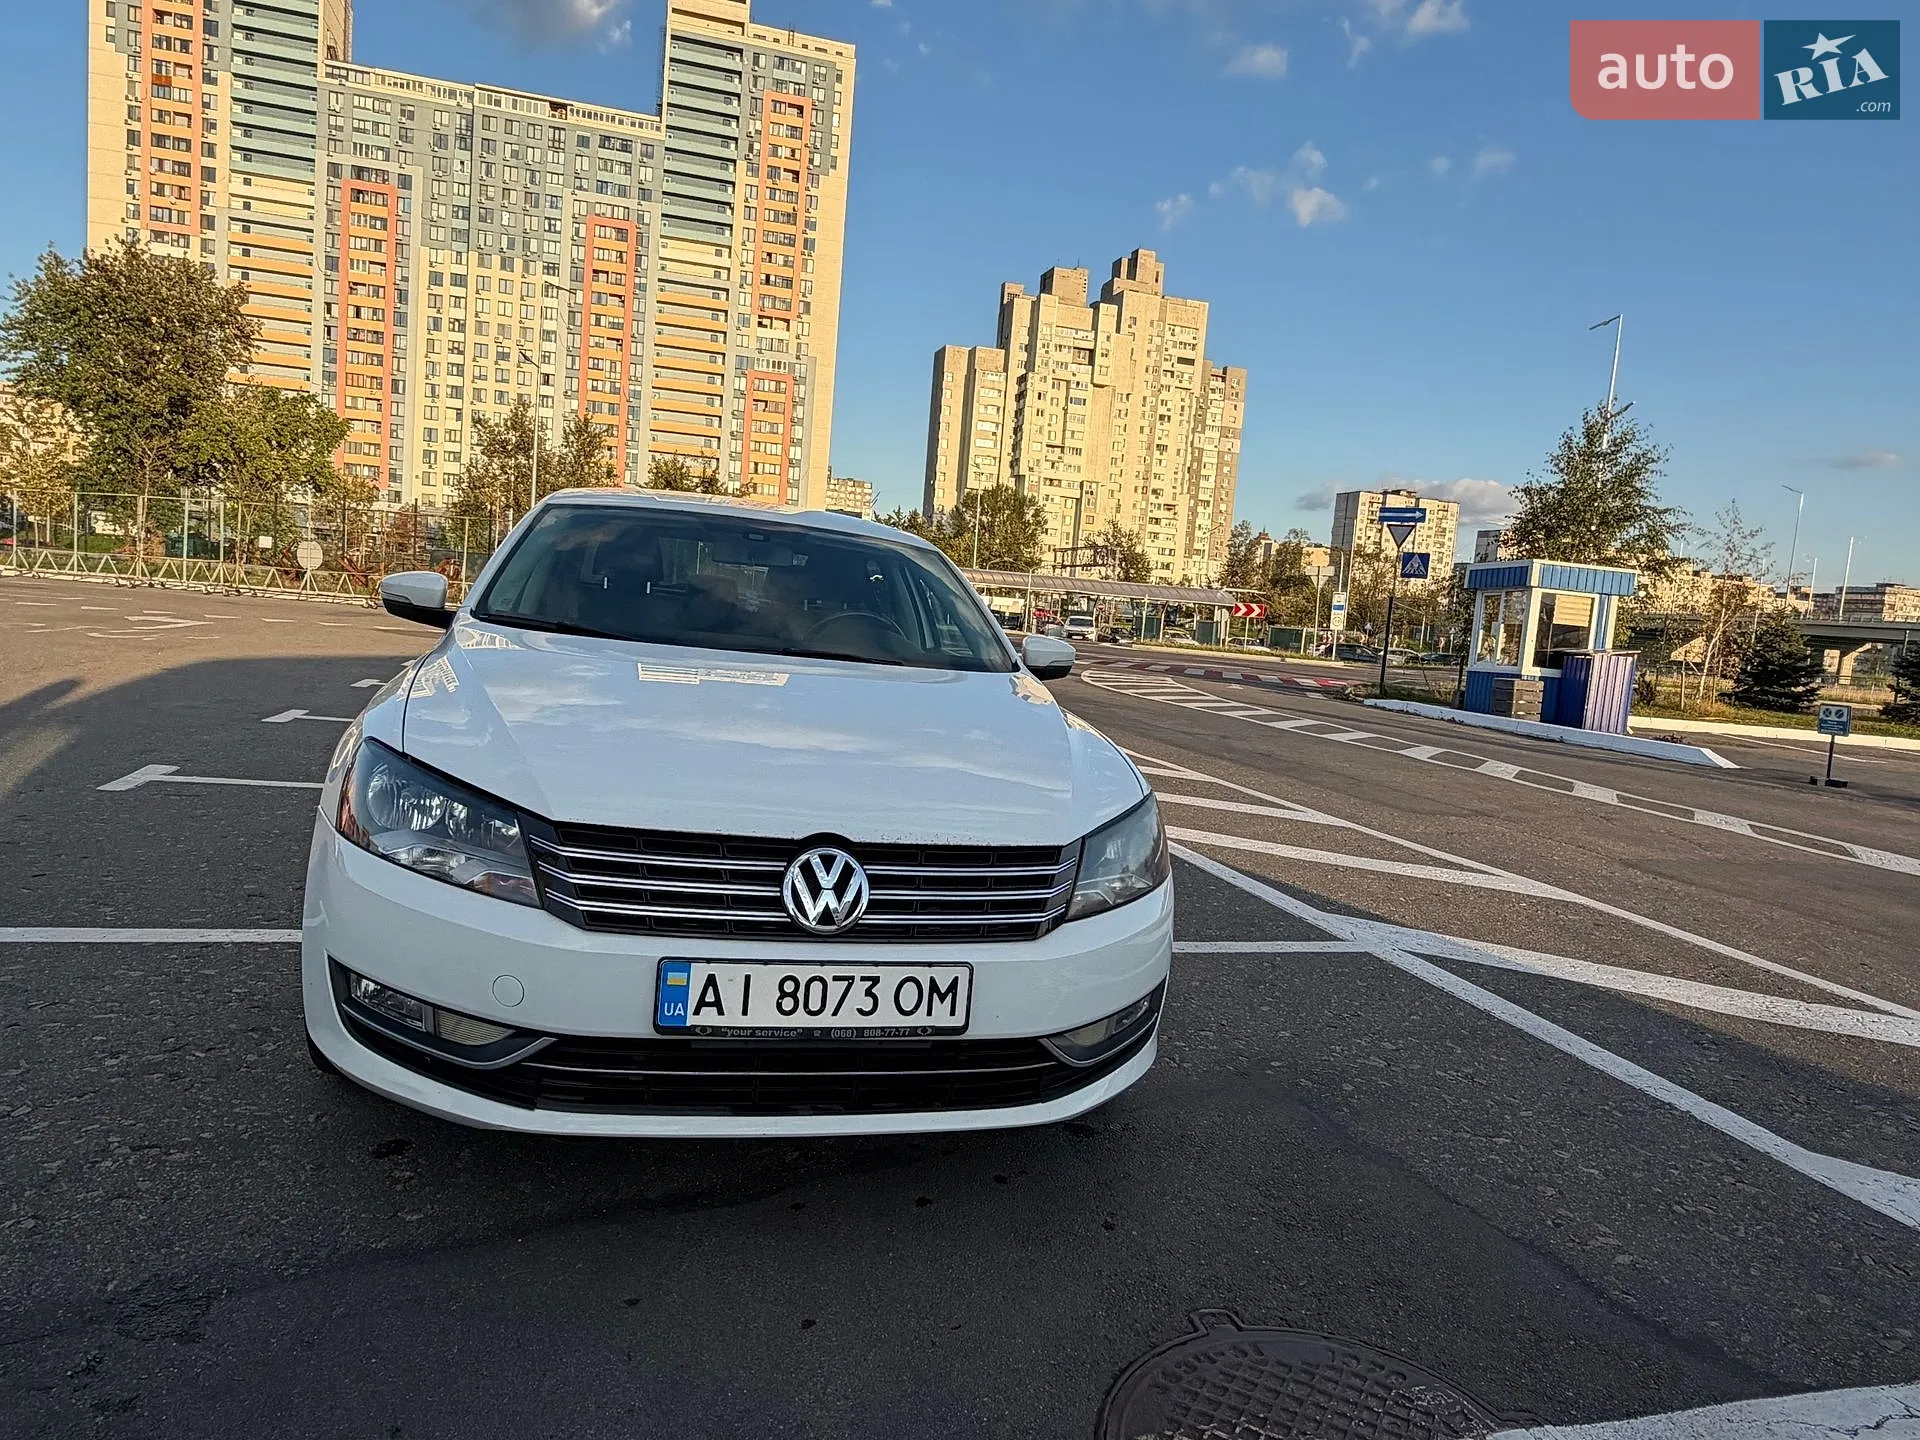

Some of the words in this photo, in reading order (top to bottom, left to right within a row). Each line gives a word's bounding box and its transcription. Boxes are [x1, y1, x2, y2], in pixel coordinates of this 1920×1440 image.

[664, 1002, 685, 1017] UA
[691, 973, 752, 1017] AI
[776, 974, 880, 1017] 8073
[893, 975, 959, 1017] OM
